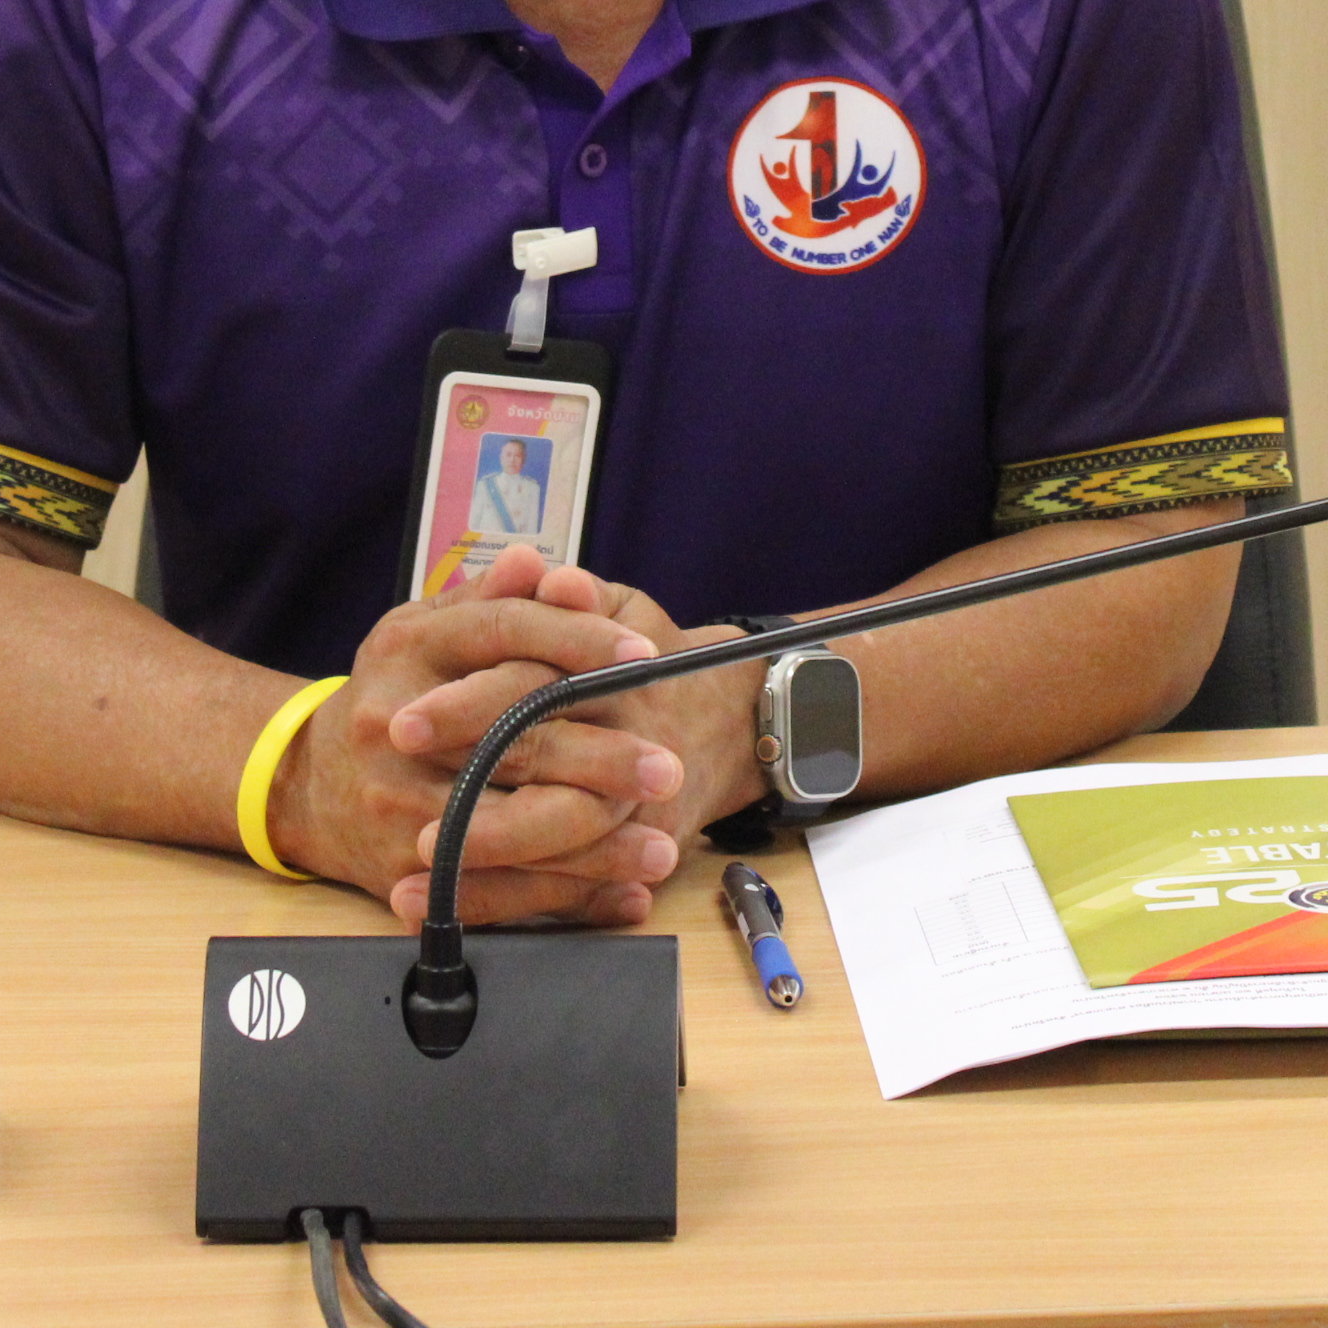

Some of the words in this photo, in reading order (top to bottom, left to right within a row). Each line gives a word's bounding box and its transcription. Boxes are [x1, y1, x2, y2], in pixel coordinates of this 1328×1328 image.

[752, 217, 769, 237] TO
[769, 235, 788, 253] BE
[791, 246, 847, 265] NUMBER
[850, 240, 878, 262] ONE
[878, 217, 904, 244] NAN
